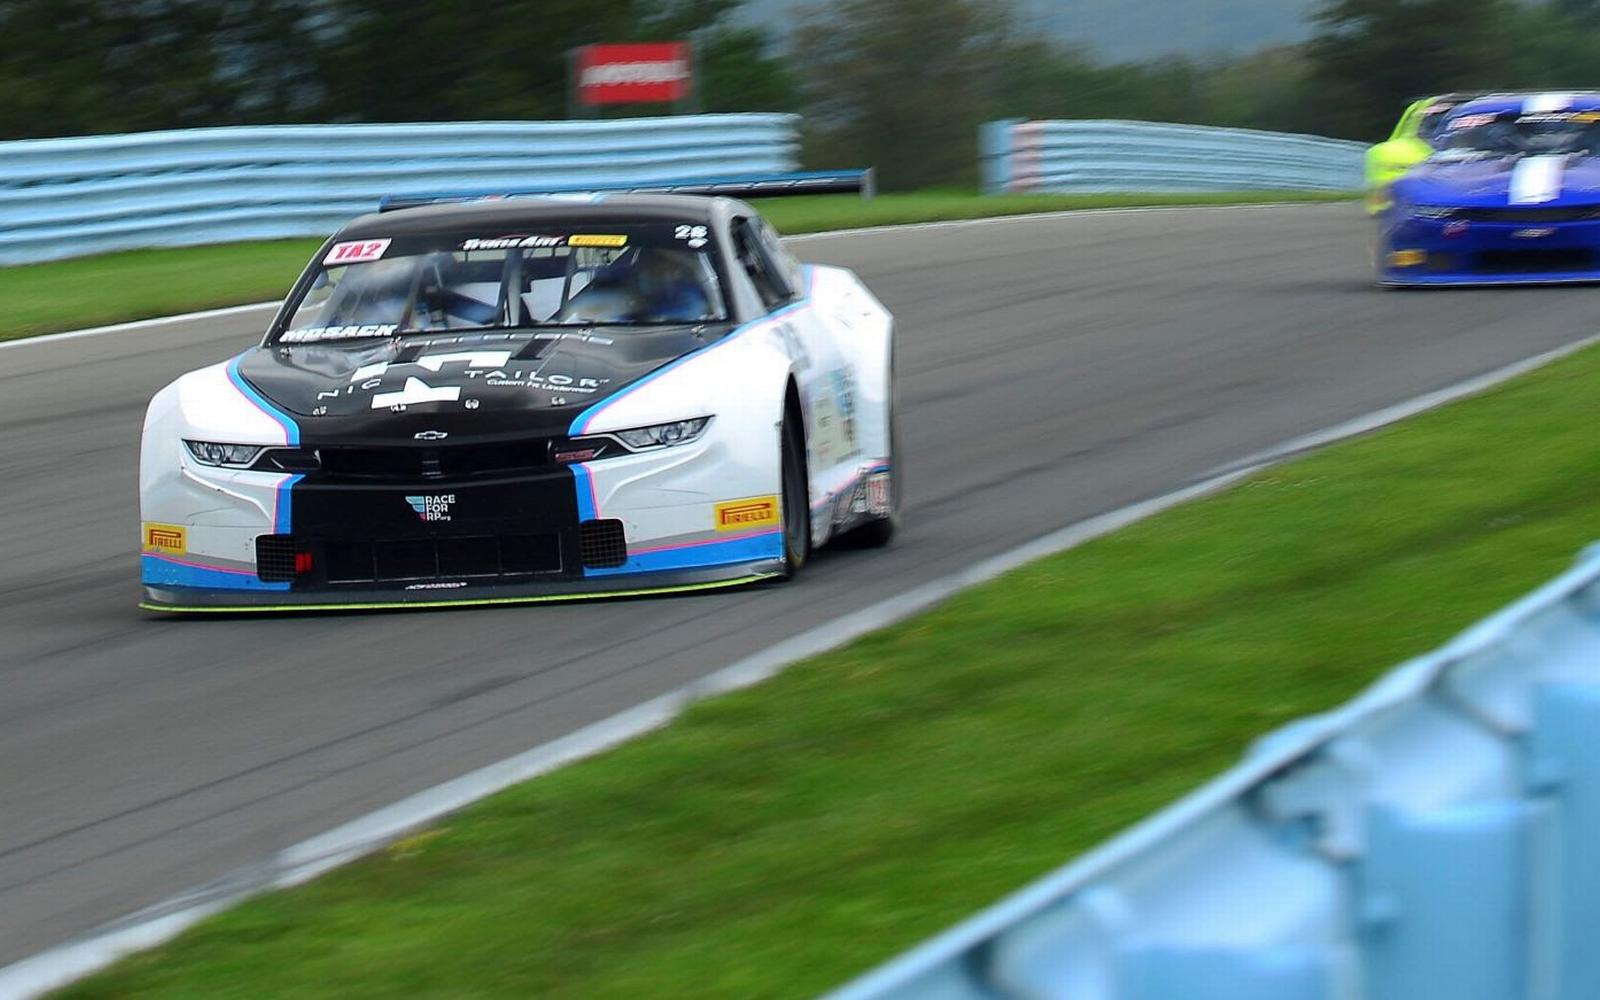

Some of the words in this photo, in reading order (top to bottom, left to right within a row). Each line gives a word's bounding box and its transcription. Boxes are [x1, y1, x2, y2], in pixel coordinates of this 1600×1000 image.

[335, 242, 382, 260] TA2
[279, 324, 398, 342] MOSACK
[317, 378, 383, 400] NIC
[464, 370, 600, 387] TAILOR
[425, 494, 456, 504] RACE
[426, 503, 448, 512] FOR
[720, 502, 771, 525] PIRELLI
[150, 529, 181, 549] PIRELLI
